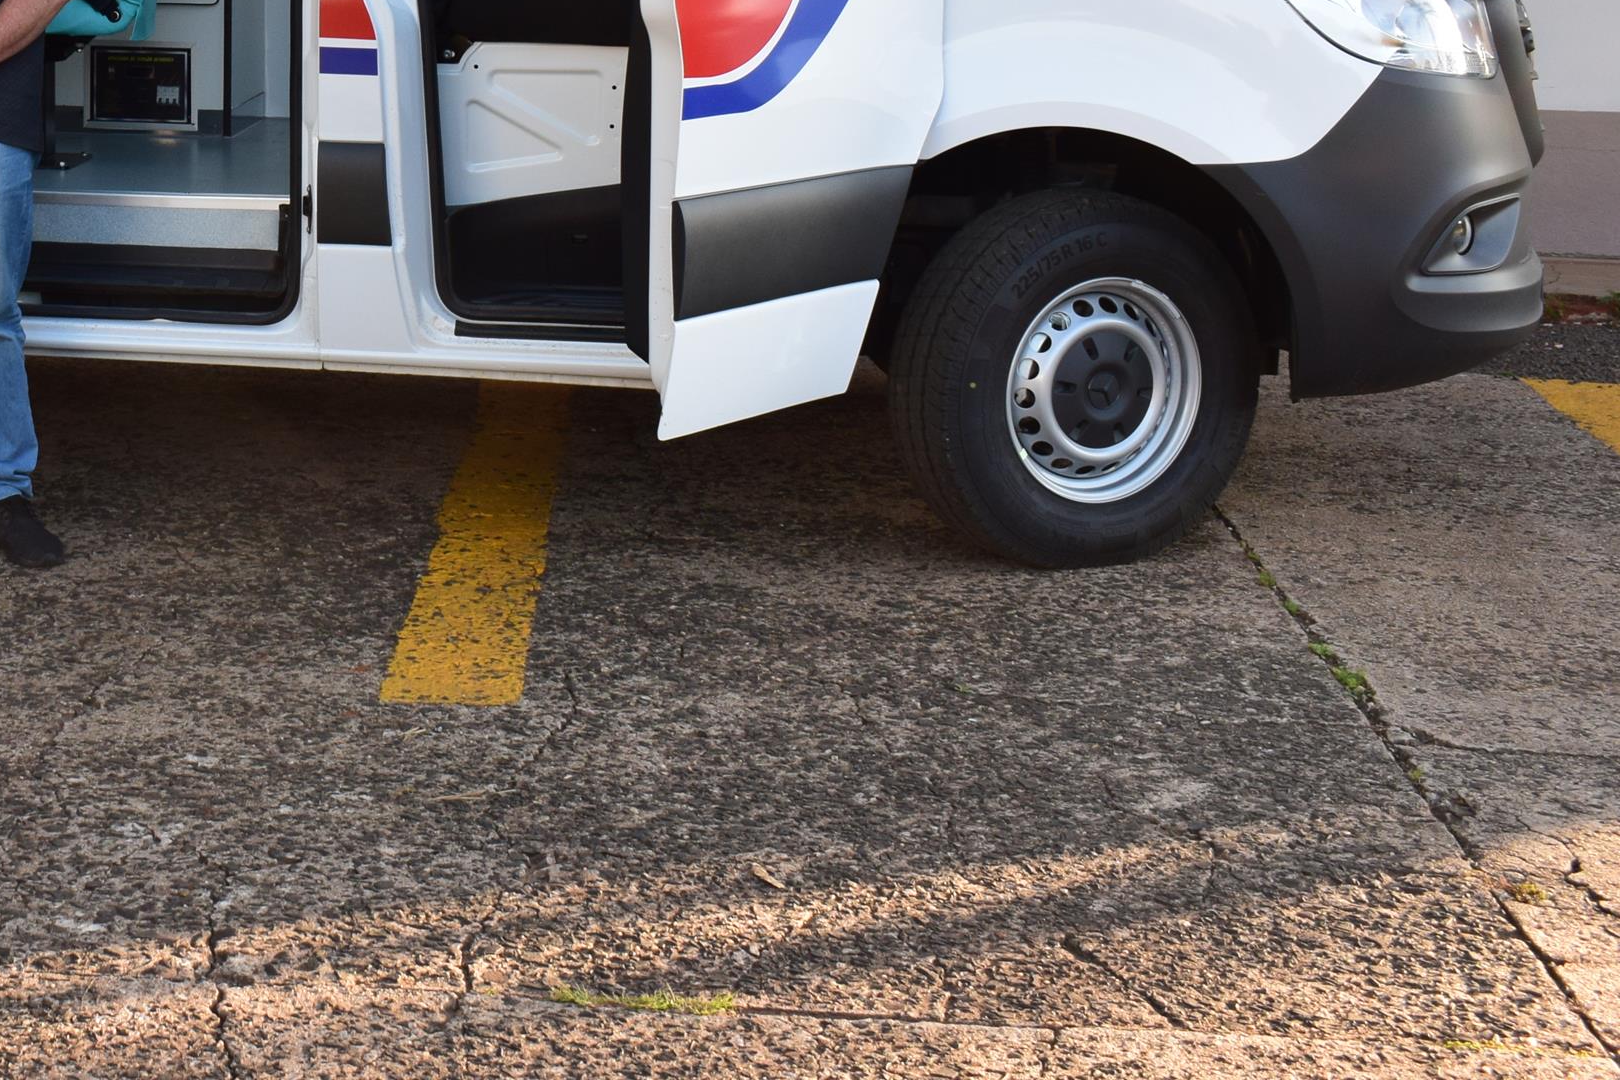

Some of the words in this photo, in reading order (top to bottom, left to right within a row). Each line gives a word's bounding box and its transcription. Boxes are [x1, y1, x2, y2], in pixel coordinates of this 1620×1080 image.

[1011, 250, 1060, 299] 225/75
[1061, 243, 1074, 258] R
[1076, 235, 1093, 253] 16
[1096, 232, 1107, 248] C
